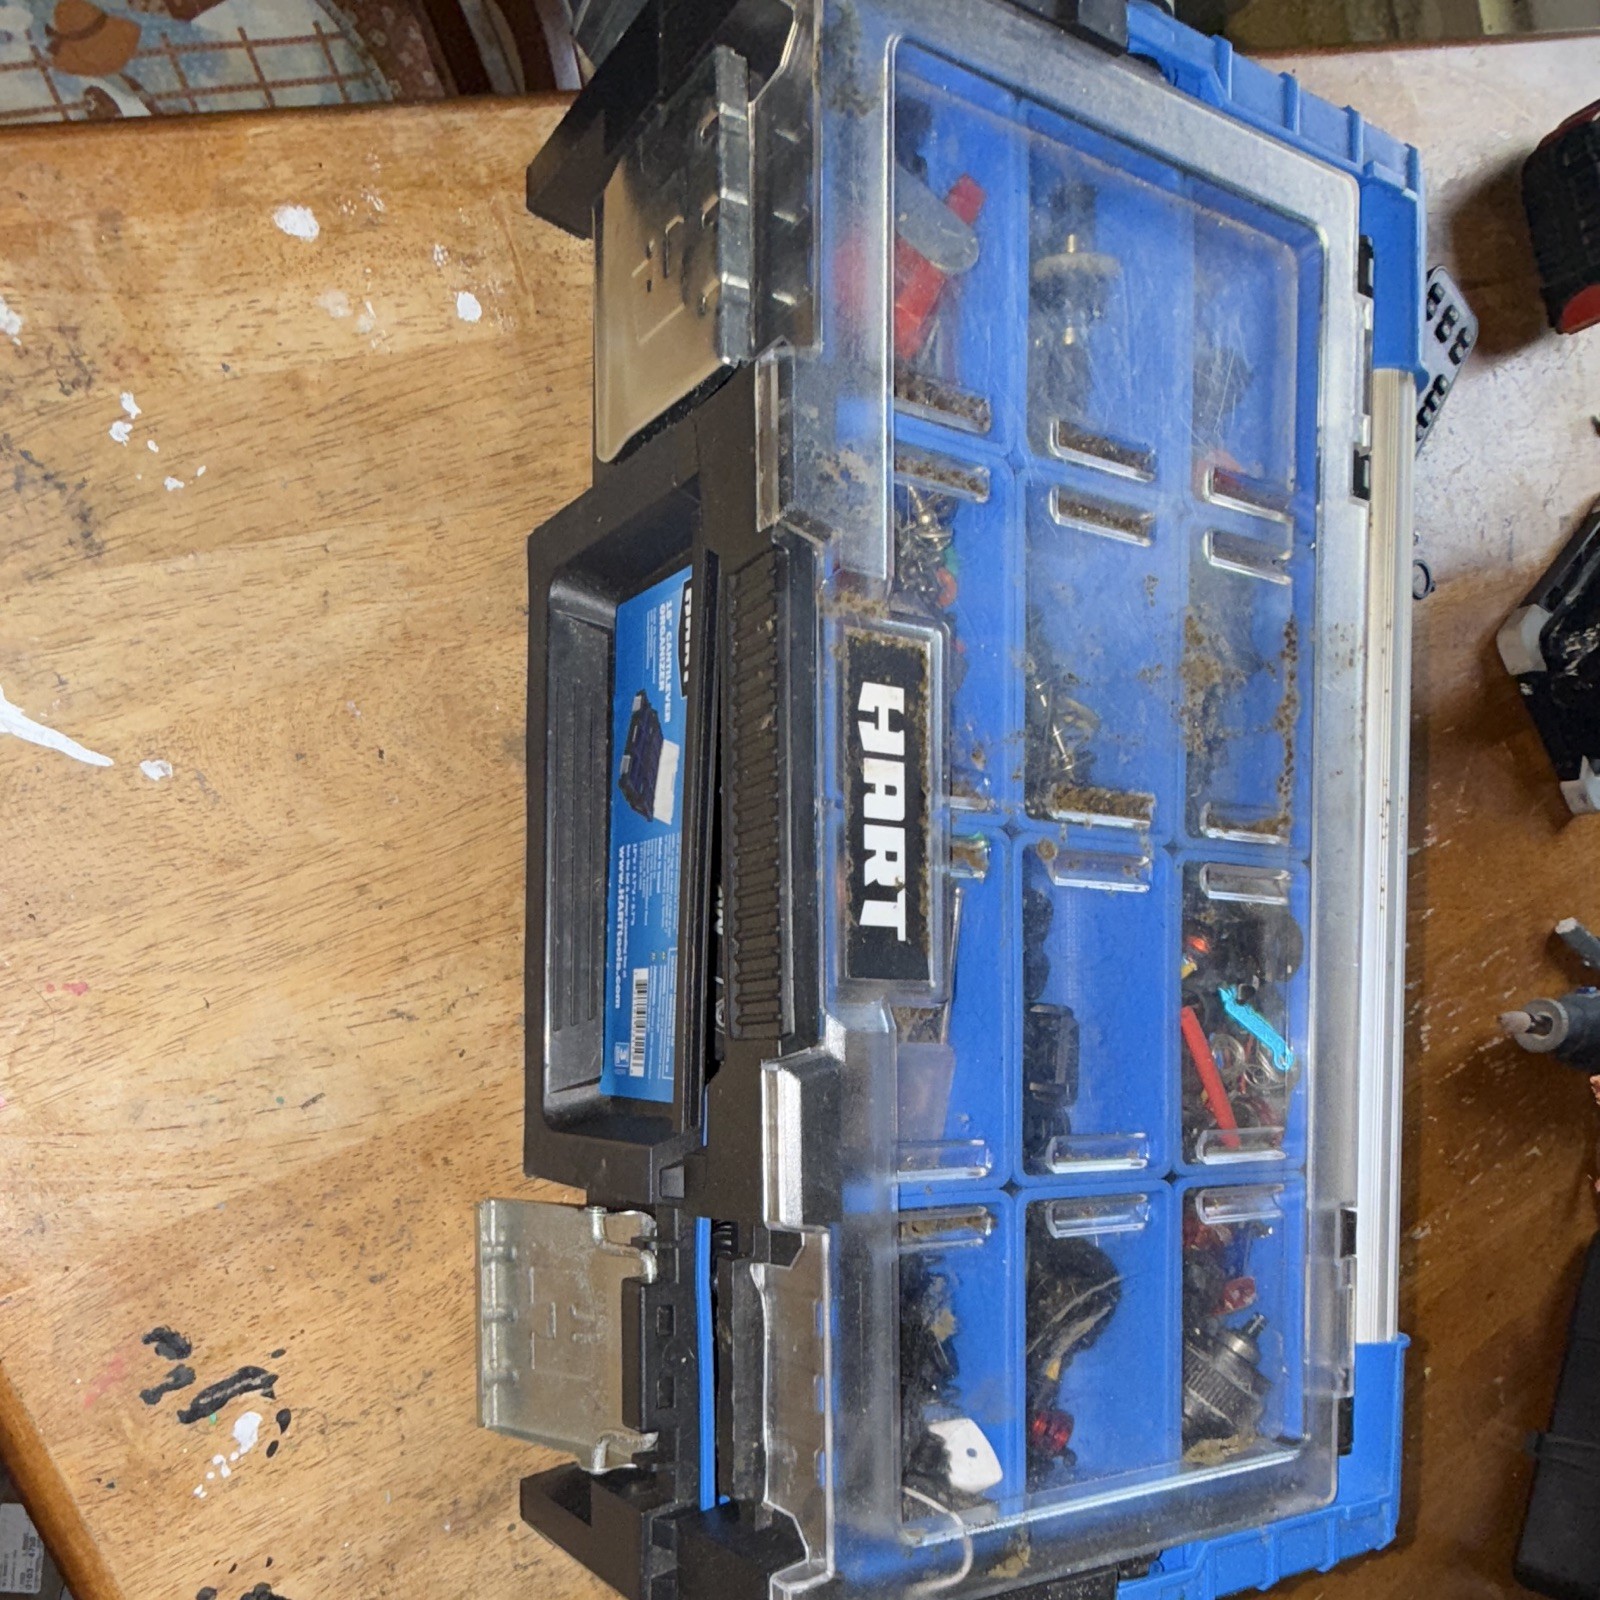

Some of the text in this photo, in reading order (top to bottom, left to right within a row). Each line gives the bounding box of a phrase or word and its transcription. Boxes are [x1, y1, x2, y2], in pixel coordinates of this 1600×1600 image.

[658, 603, 666, 691] ORGANIZER
[664, 631, 672, 723] CANTILEVER
[857, 682, 905, 941] HART
[615, 846, 625, 1009] www.HARTtools.com
